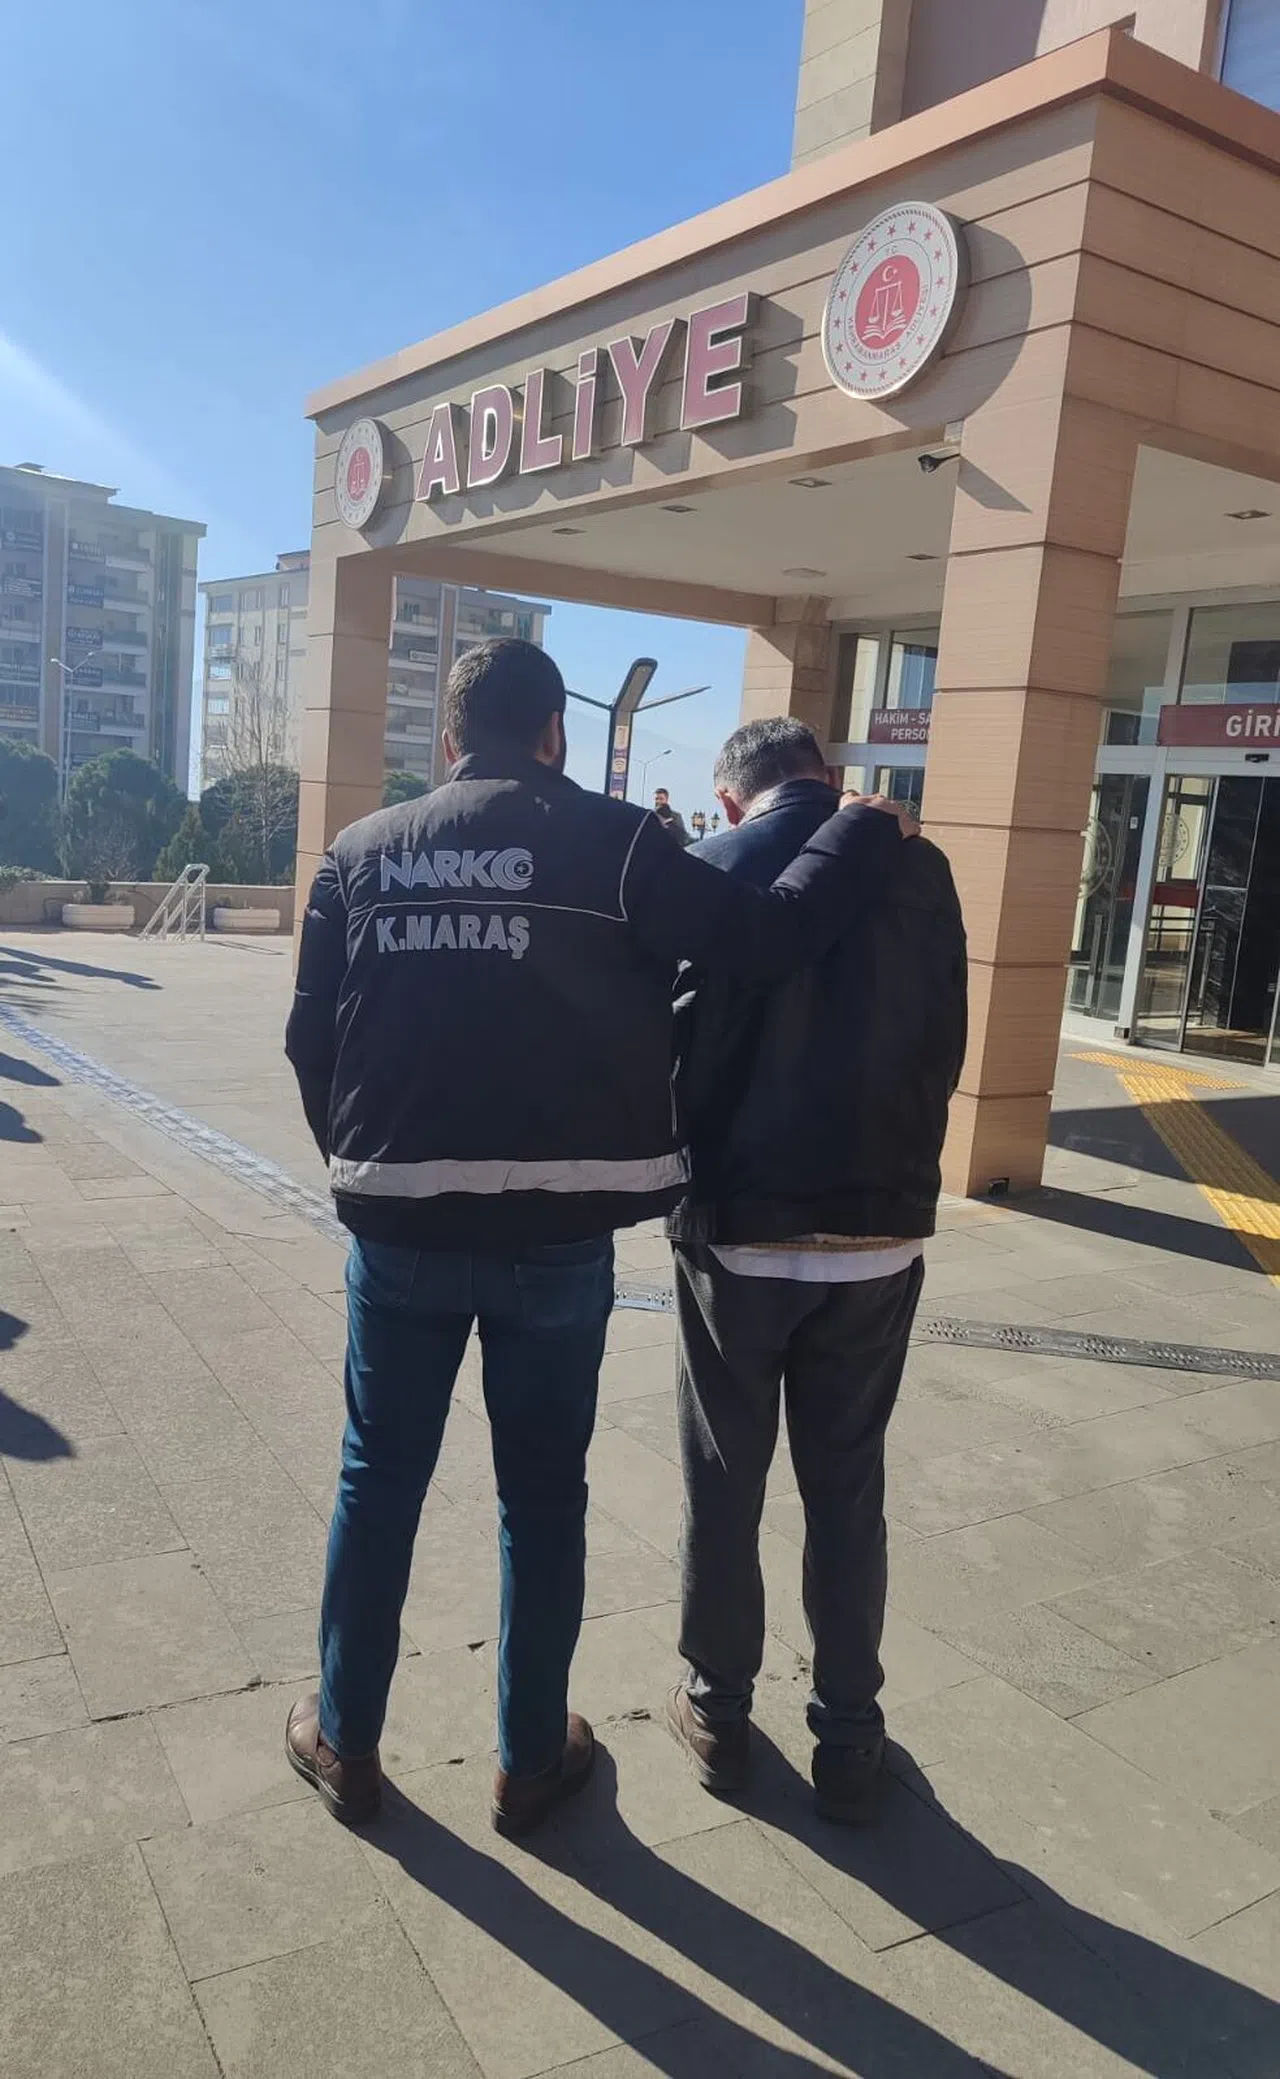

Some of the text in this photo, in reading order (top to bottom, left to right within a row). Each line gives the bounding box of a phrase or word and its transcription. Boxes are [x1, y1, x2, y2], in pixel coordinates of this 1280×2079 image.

[415, 291, 757, 502] ADLİYE
[874, 710, 909, 725] HAKİM
[890, 728, 930, 741] PERSO
[376, 914, 531, 960] K.MARAŞ
